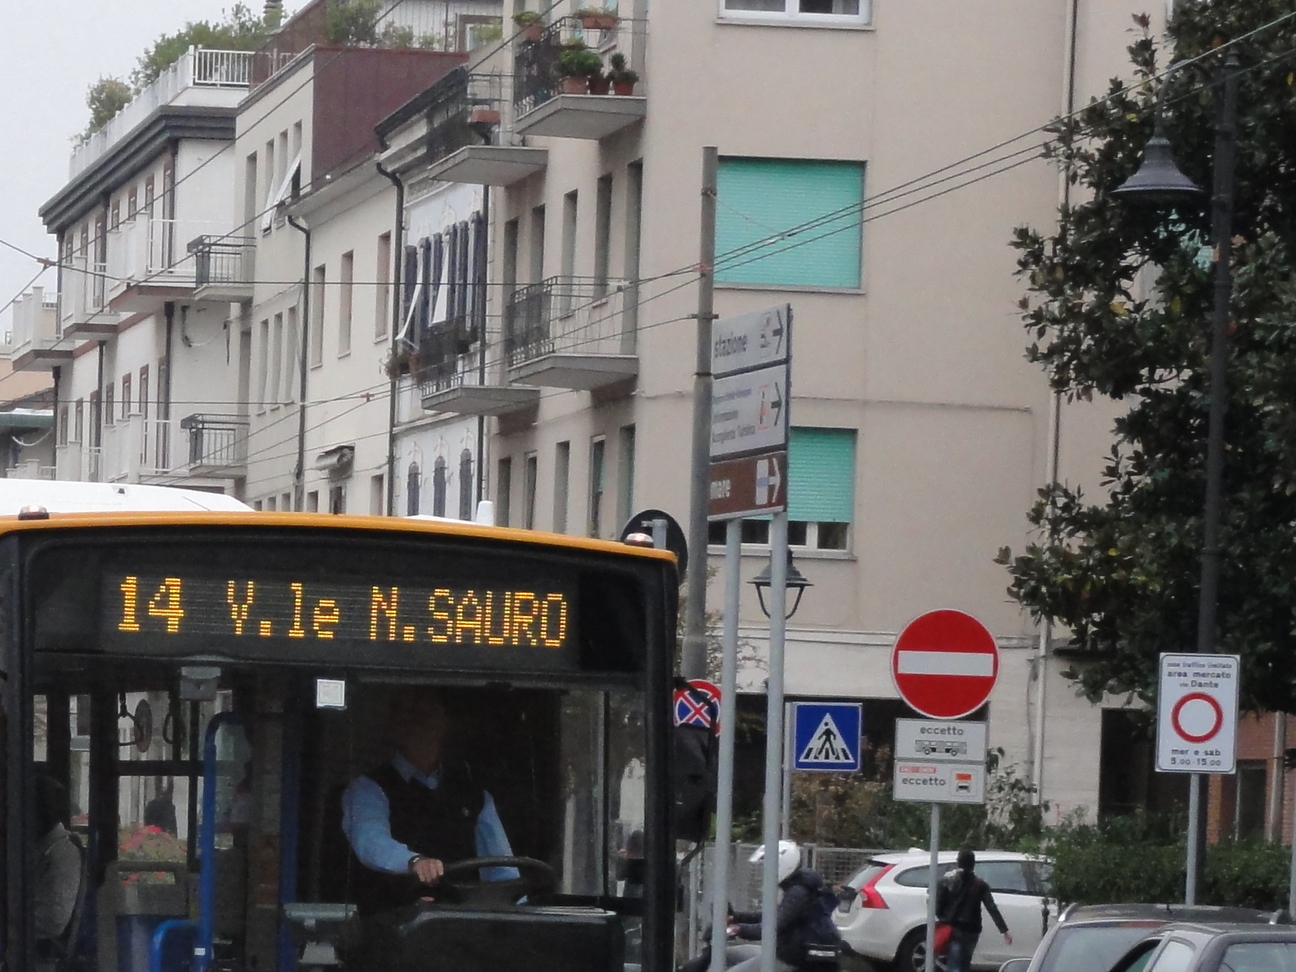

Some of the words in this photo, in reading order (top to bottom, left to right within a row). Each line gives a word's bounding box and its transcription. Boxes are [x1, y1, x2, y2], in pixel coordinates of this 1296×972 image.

[118, 576, 184, 632] 14
[1193, 671, 1232, 679] mercato
[1191, 680, 1219, 688] Dante
[920, 726, 964, 736] eccetto
[902, 777, 946, 786] eccetto
